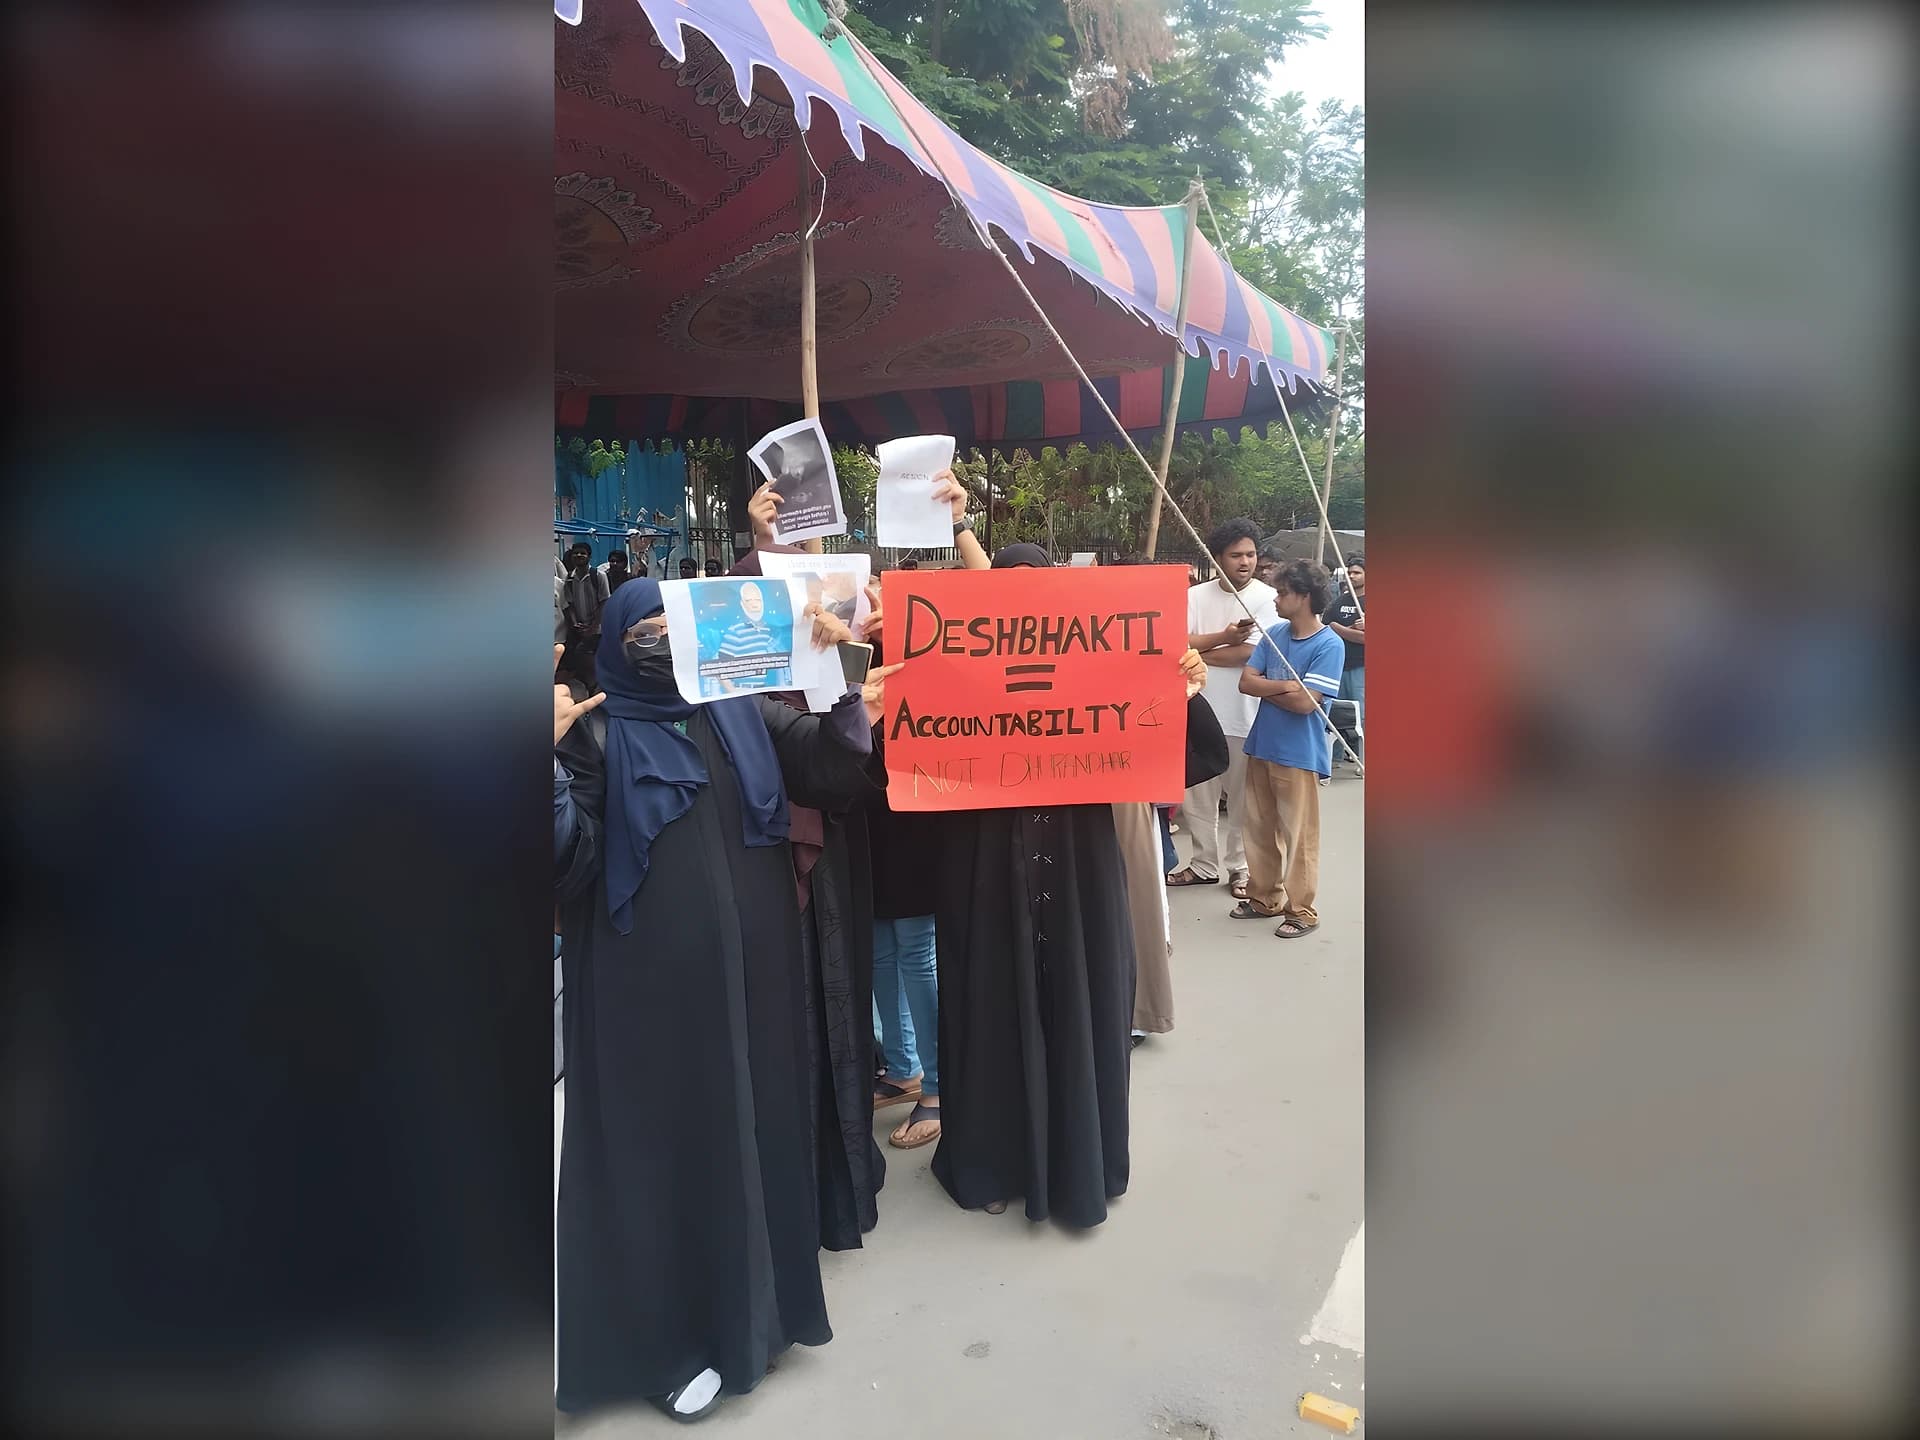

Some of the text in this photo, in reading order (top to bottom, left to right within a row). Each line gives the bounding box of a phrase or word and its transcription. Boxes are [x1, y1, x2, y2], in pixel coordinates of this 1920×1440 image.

[903, 593, 1164, 660] DESHBHAKTI
[1005, 664, 1056, 693] =
[889, 696, 1132, 741] ACCOUNTABILTY
[913, 756, 981, 799] NOT
